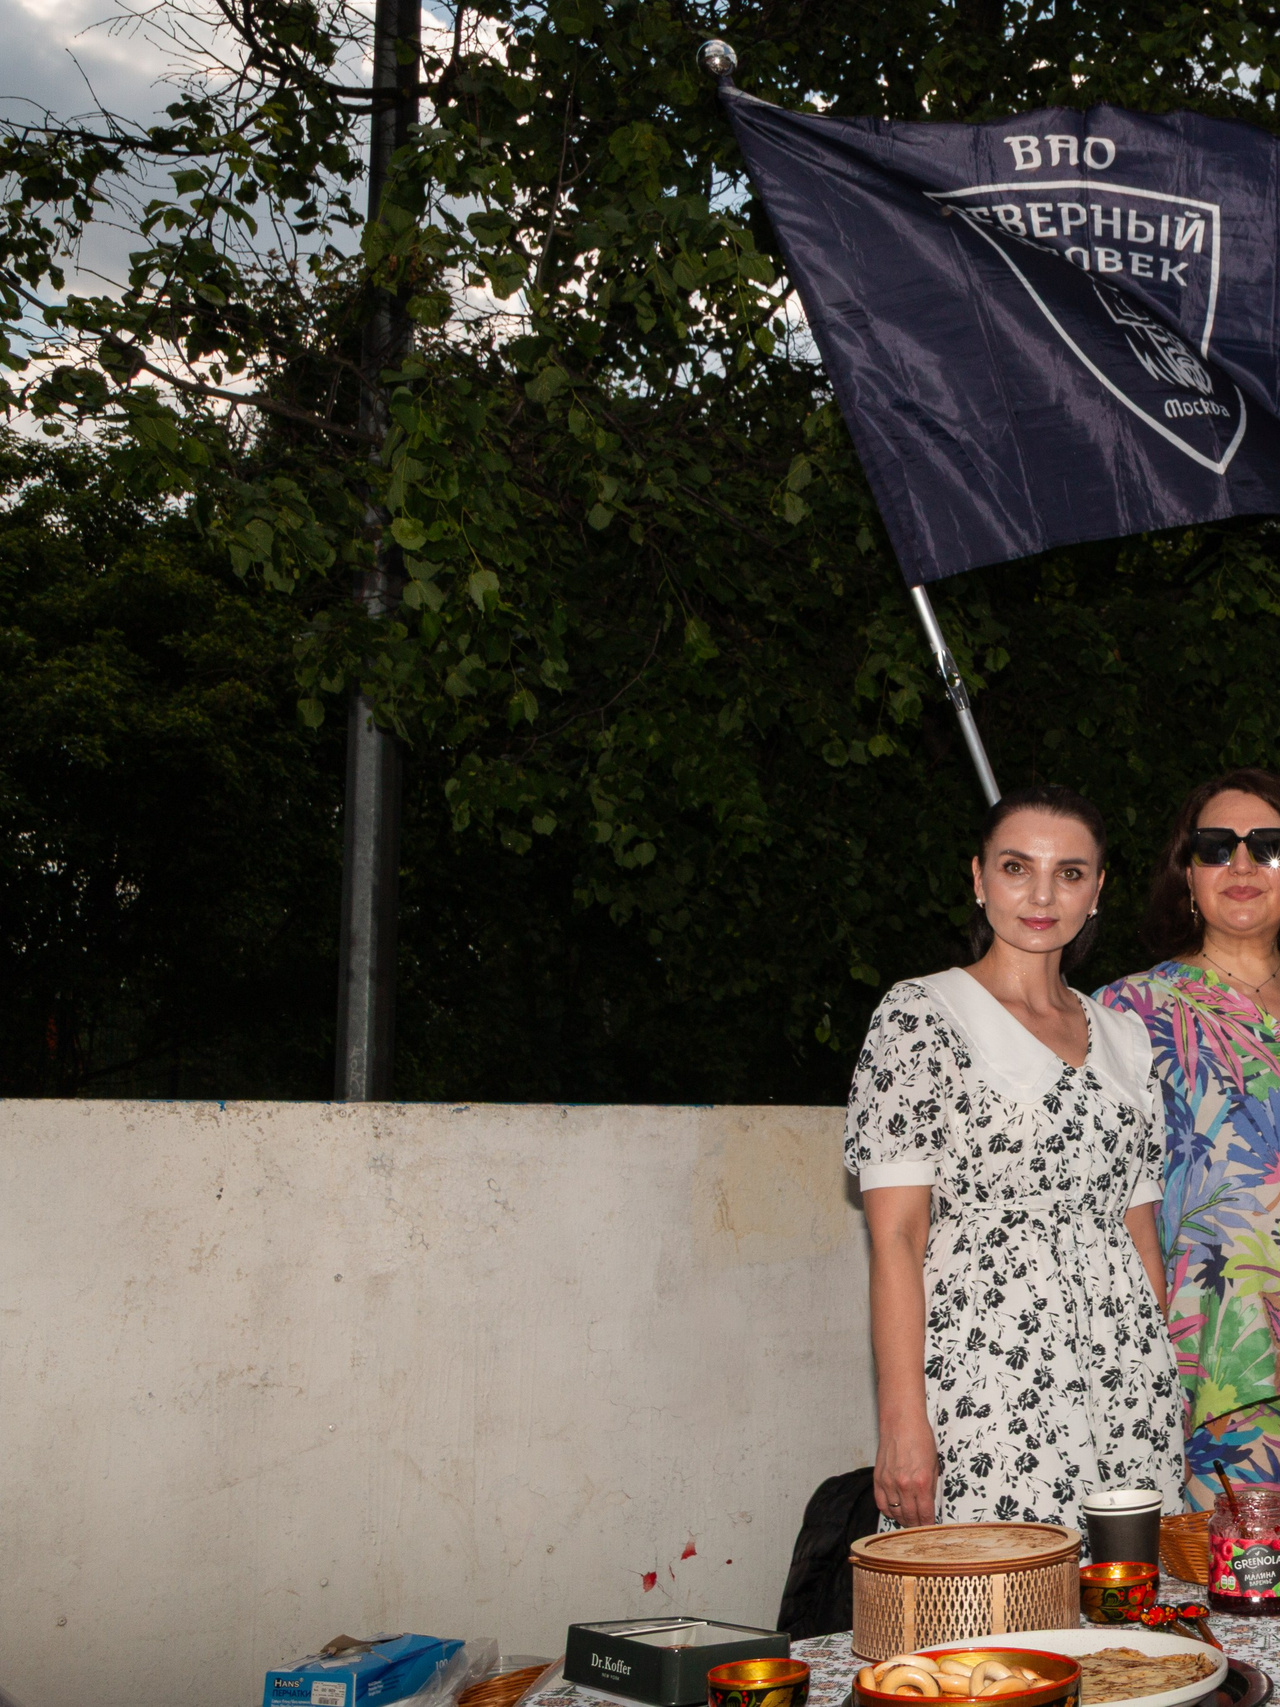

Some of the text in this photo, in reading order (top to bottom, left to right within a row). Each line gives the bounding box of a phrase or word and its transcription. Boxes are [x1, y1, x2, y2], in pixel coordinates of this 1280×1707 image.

[1003, 134, 1116, 171] ВАО
[1064, 246, 1188, 287] ОВЕК
[1244, 1571, 1276, 1582] МАЛИНА
[591, 1653, 632, 1676] Dr.Koffer
[274, 1679, 300, 1688] HANS
[272, 1689, 312, 1698] ПЕРЧАТКИ
